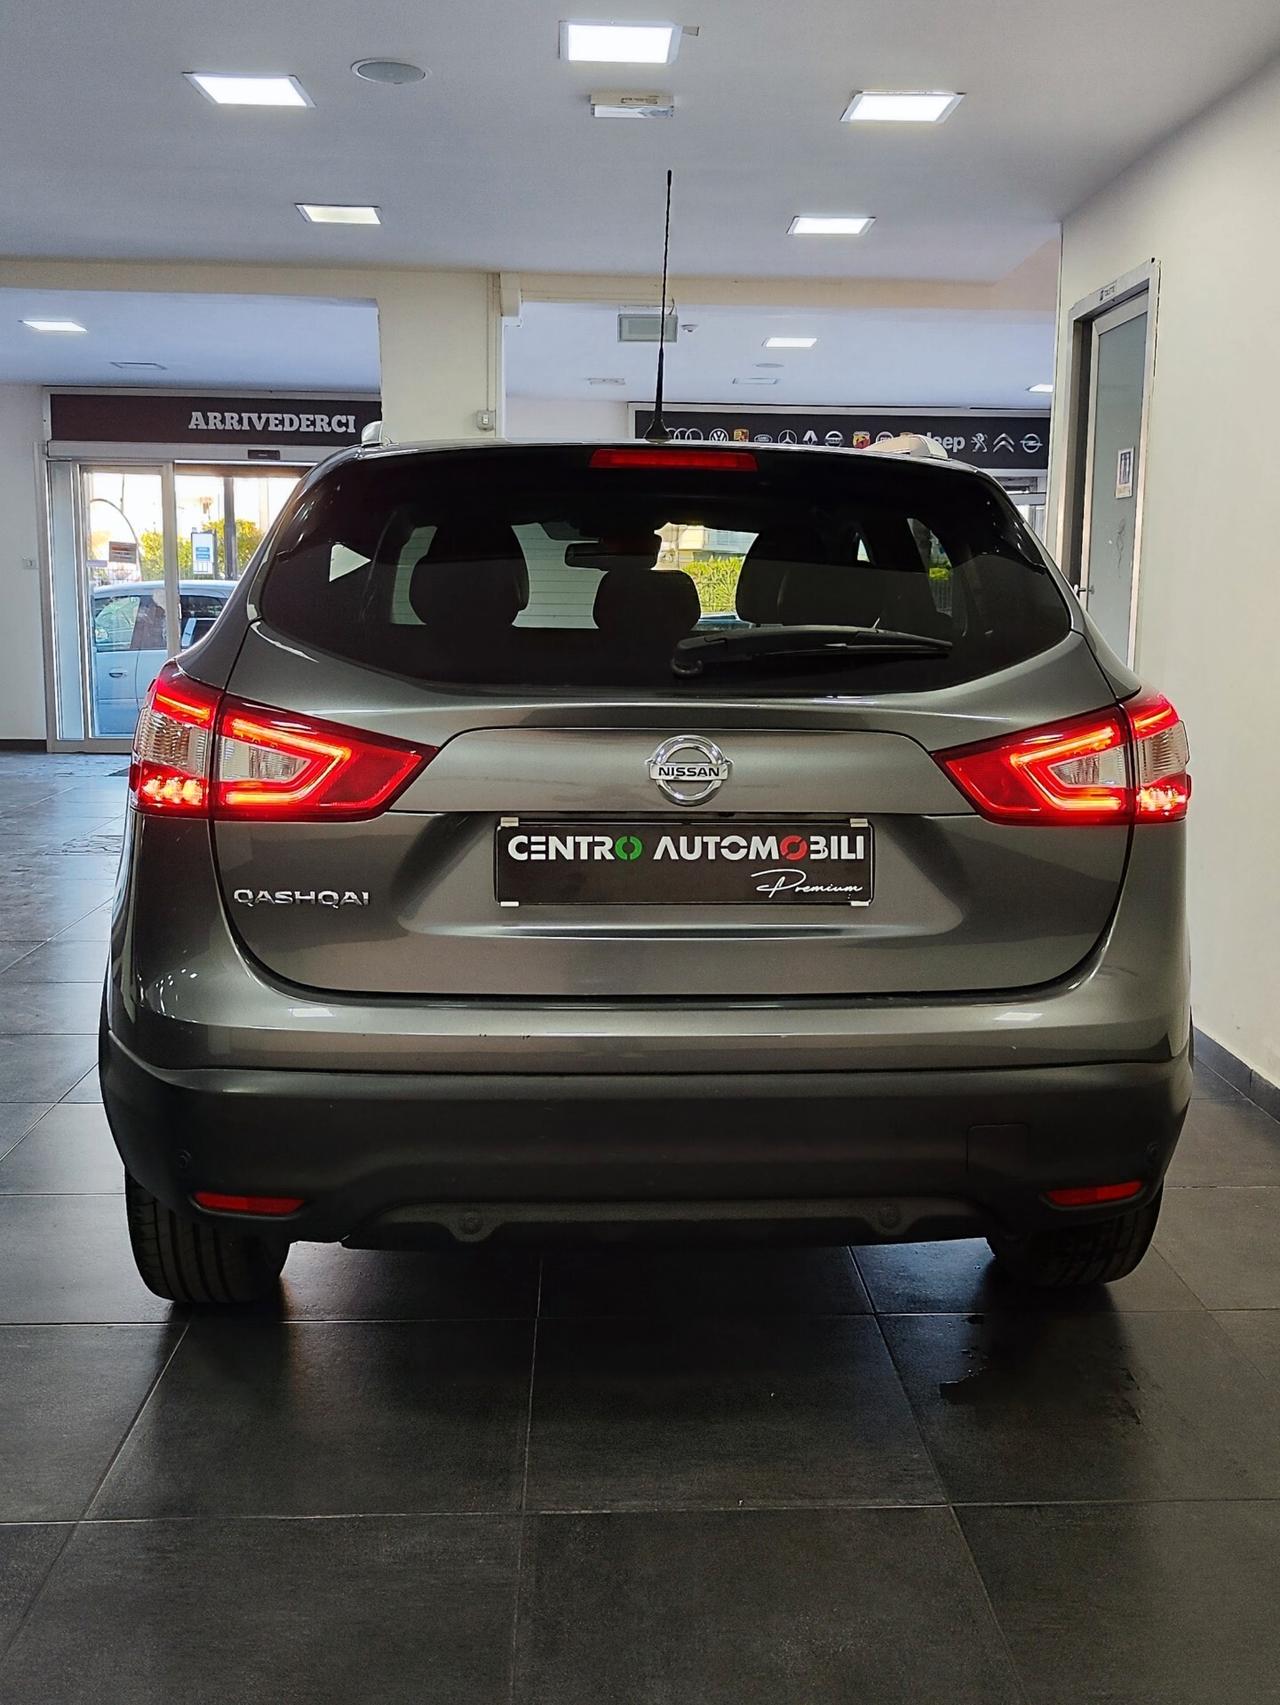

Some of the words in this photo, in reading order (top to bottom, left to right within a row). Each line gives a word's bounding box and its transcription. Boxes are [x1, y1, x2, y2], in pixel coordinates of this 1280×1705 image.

[188, 412, 356, 433] ARRIVEDERCI
[658, 767, 719, 777] NISSAN
[507, 835, 643, 861] CENTRO
[653, 835, 864, 861] AUTOMOBILI
[750, 868, 863, 898] Premium
[233, 889, 369, 909] QASHQAI
